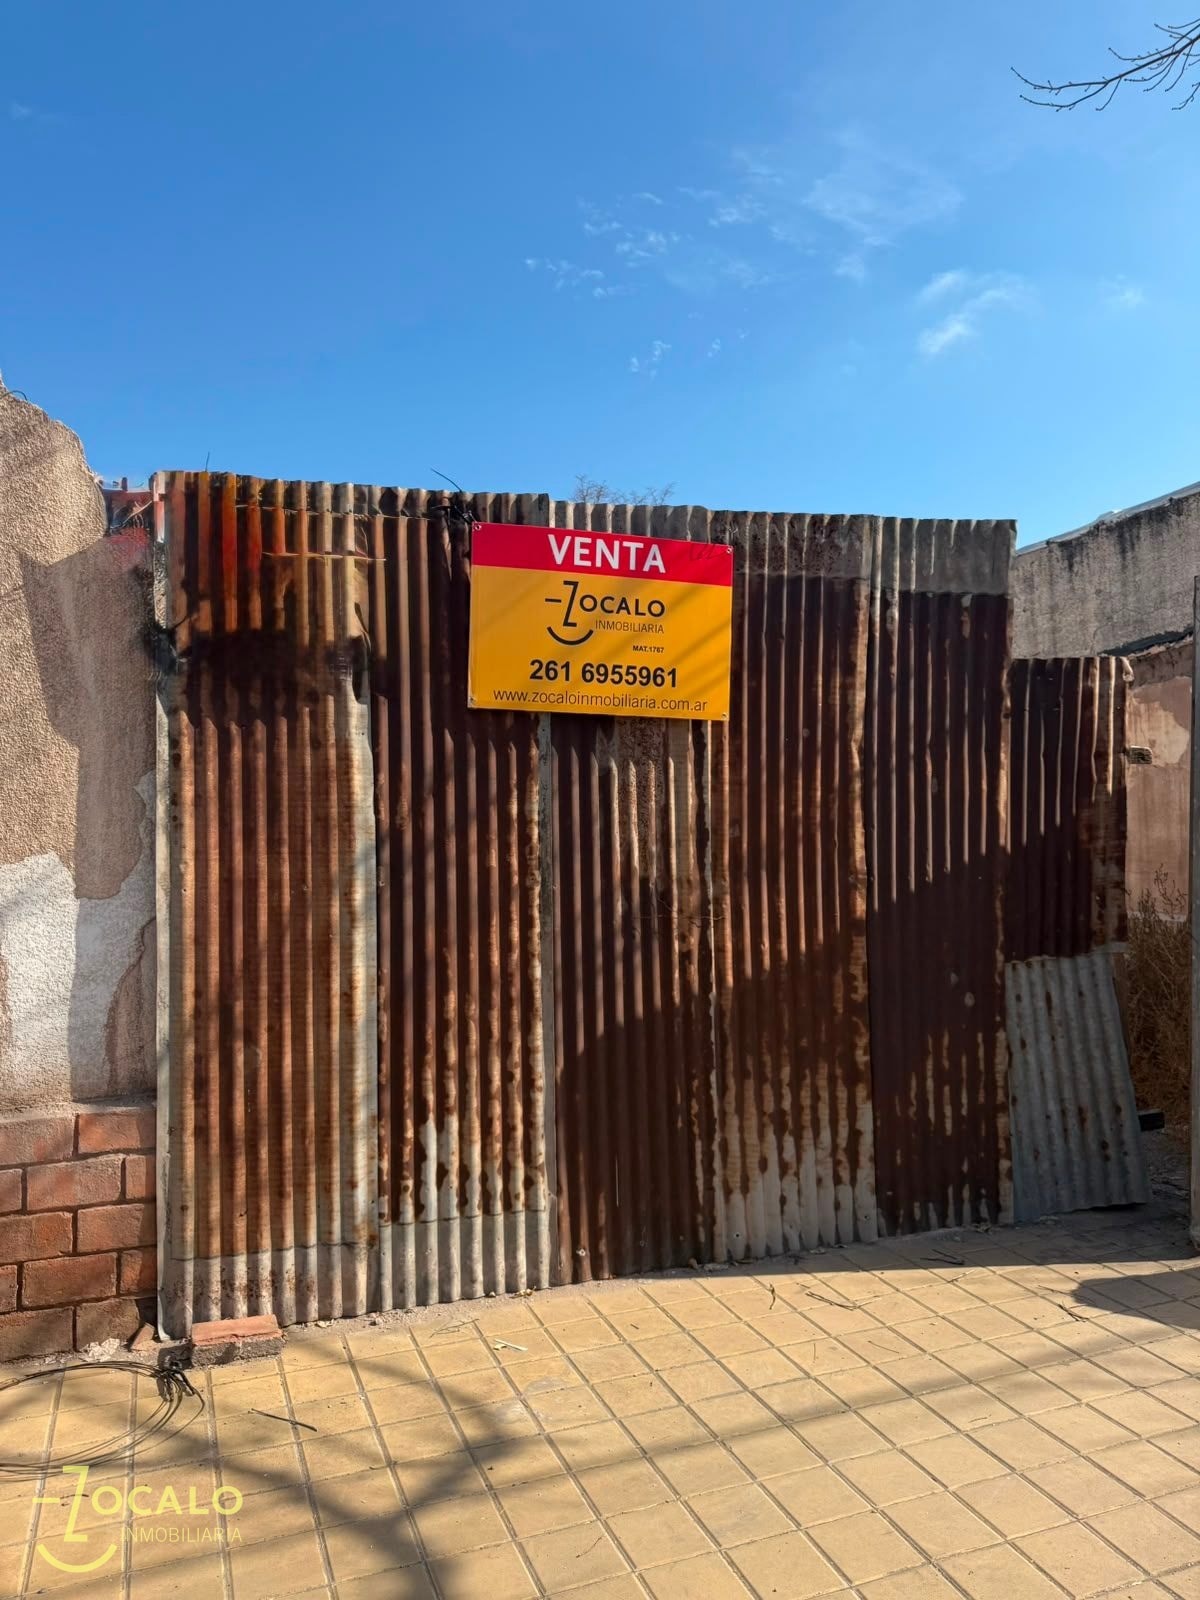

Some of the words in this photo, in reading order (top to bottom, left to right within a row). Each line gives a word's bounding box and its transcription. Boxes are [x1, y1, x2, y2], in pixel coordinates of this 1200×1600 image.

[548, 534, 666, 573] VENTA
[563, 580, 665, 627] ZOCALO
[595, 620, 664, 633] INMOBILIARIA
[529, 659, 570, 681] 261
[581, 662, 677, 687] 6955961
[493, 689, 707, 712] www.zocaloinmobiliaria.com.ar
